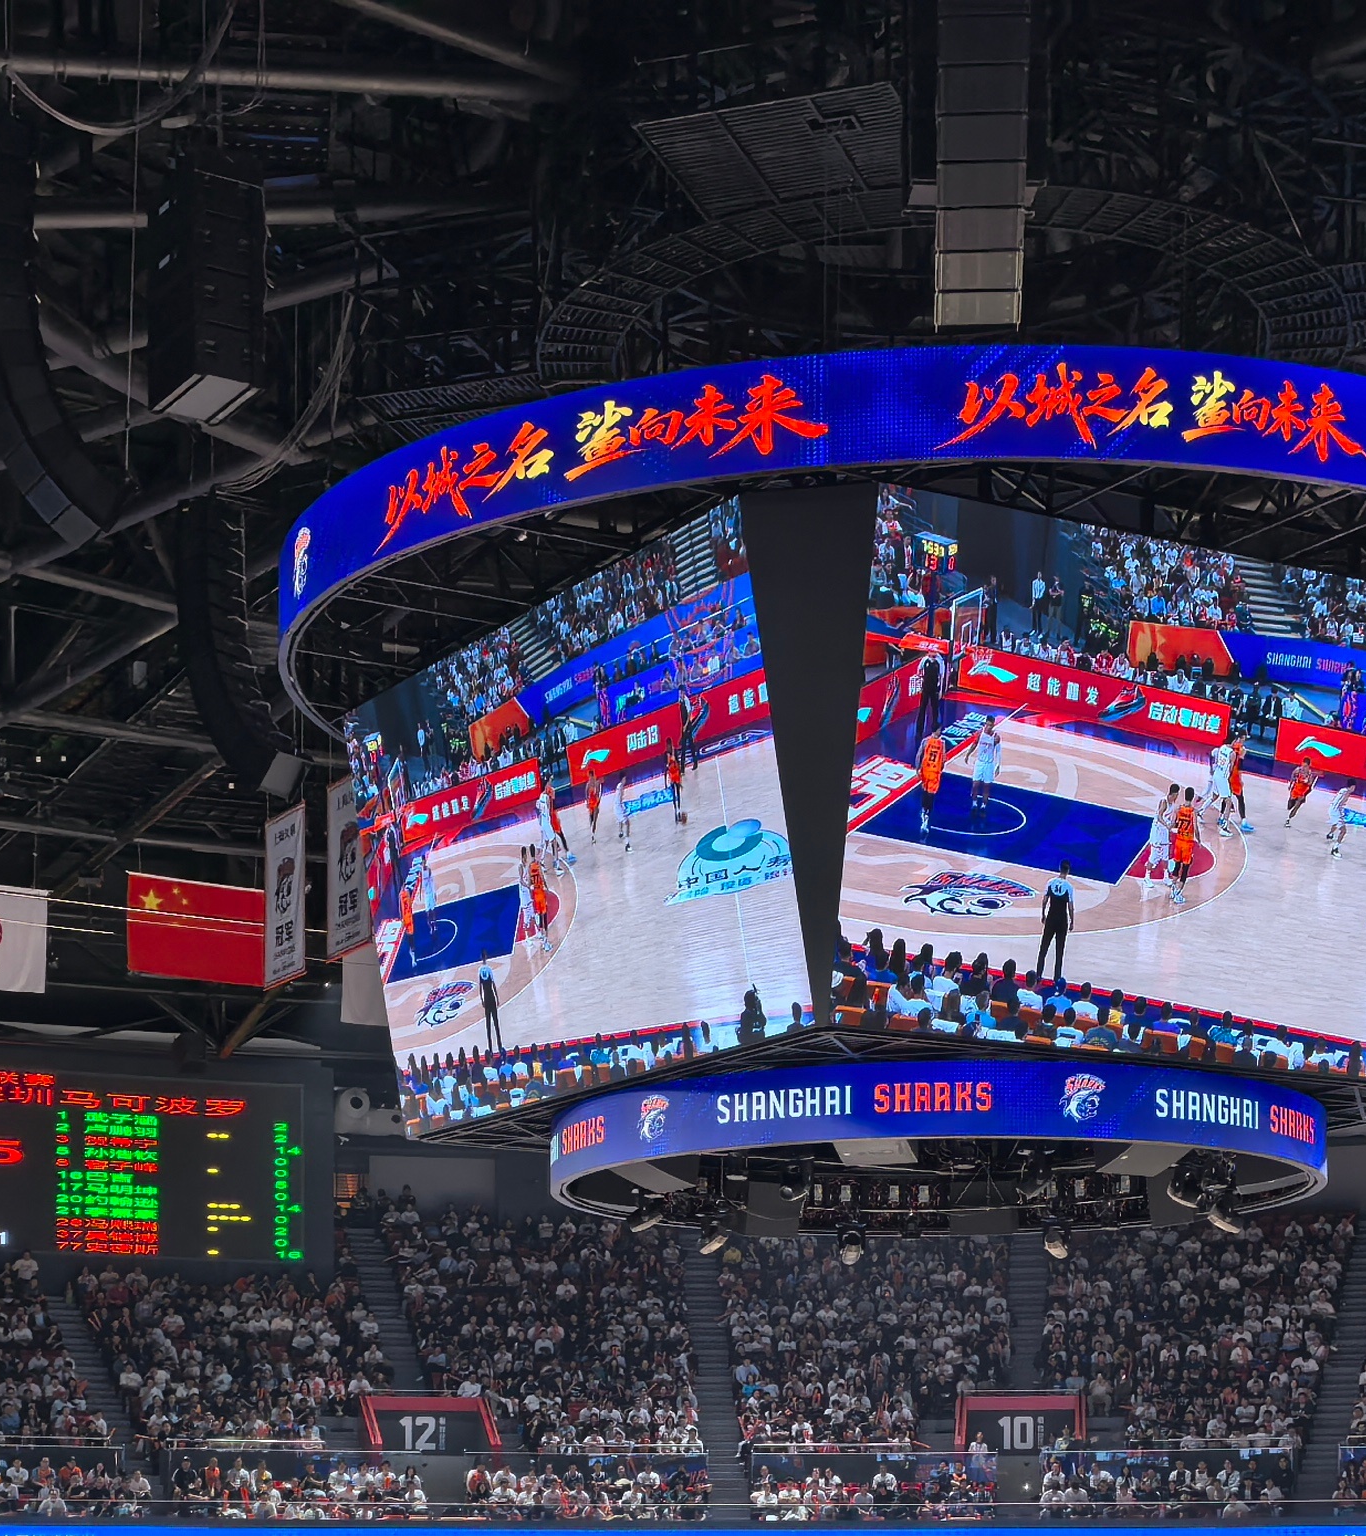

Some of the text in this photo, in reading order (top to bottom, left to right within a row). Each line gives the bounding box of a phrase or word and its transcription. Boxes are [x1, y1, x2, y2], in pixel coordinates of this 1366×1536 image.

[933, 364, 1175, 452] 以城之名
[373, 372, 830, 556] 以城之名 鲨向未来
[1026, 671, 1101, 707] 超能发
[716, 1081, 993, 1124] SHANGHAI SHARKS
[1154, 1089, 1316, 1144] SHANGHAI SHARKS
[562, 1116, 605, 1154] SHARKS
[399, 1416, 436, 1450] 12
[998, 1416, 1033, 1450] 10
